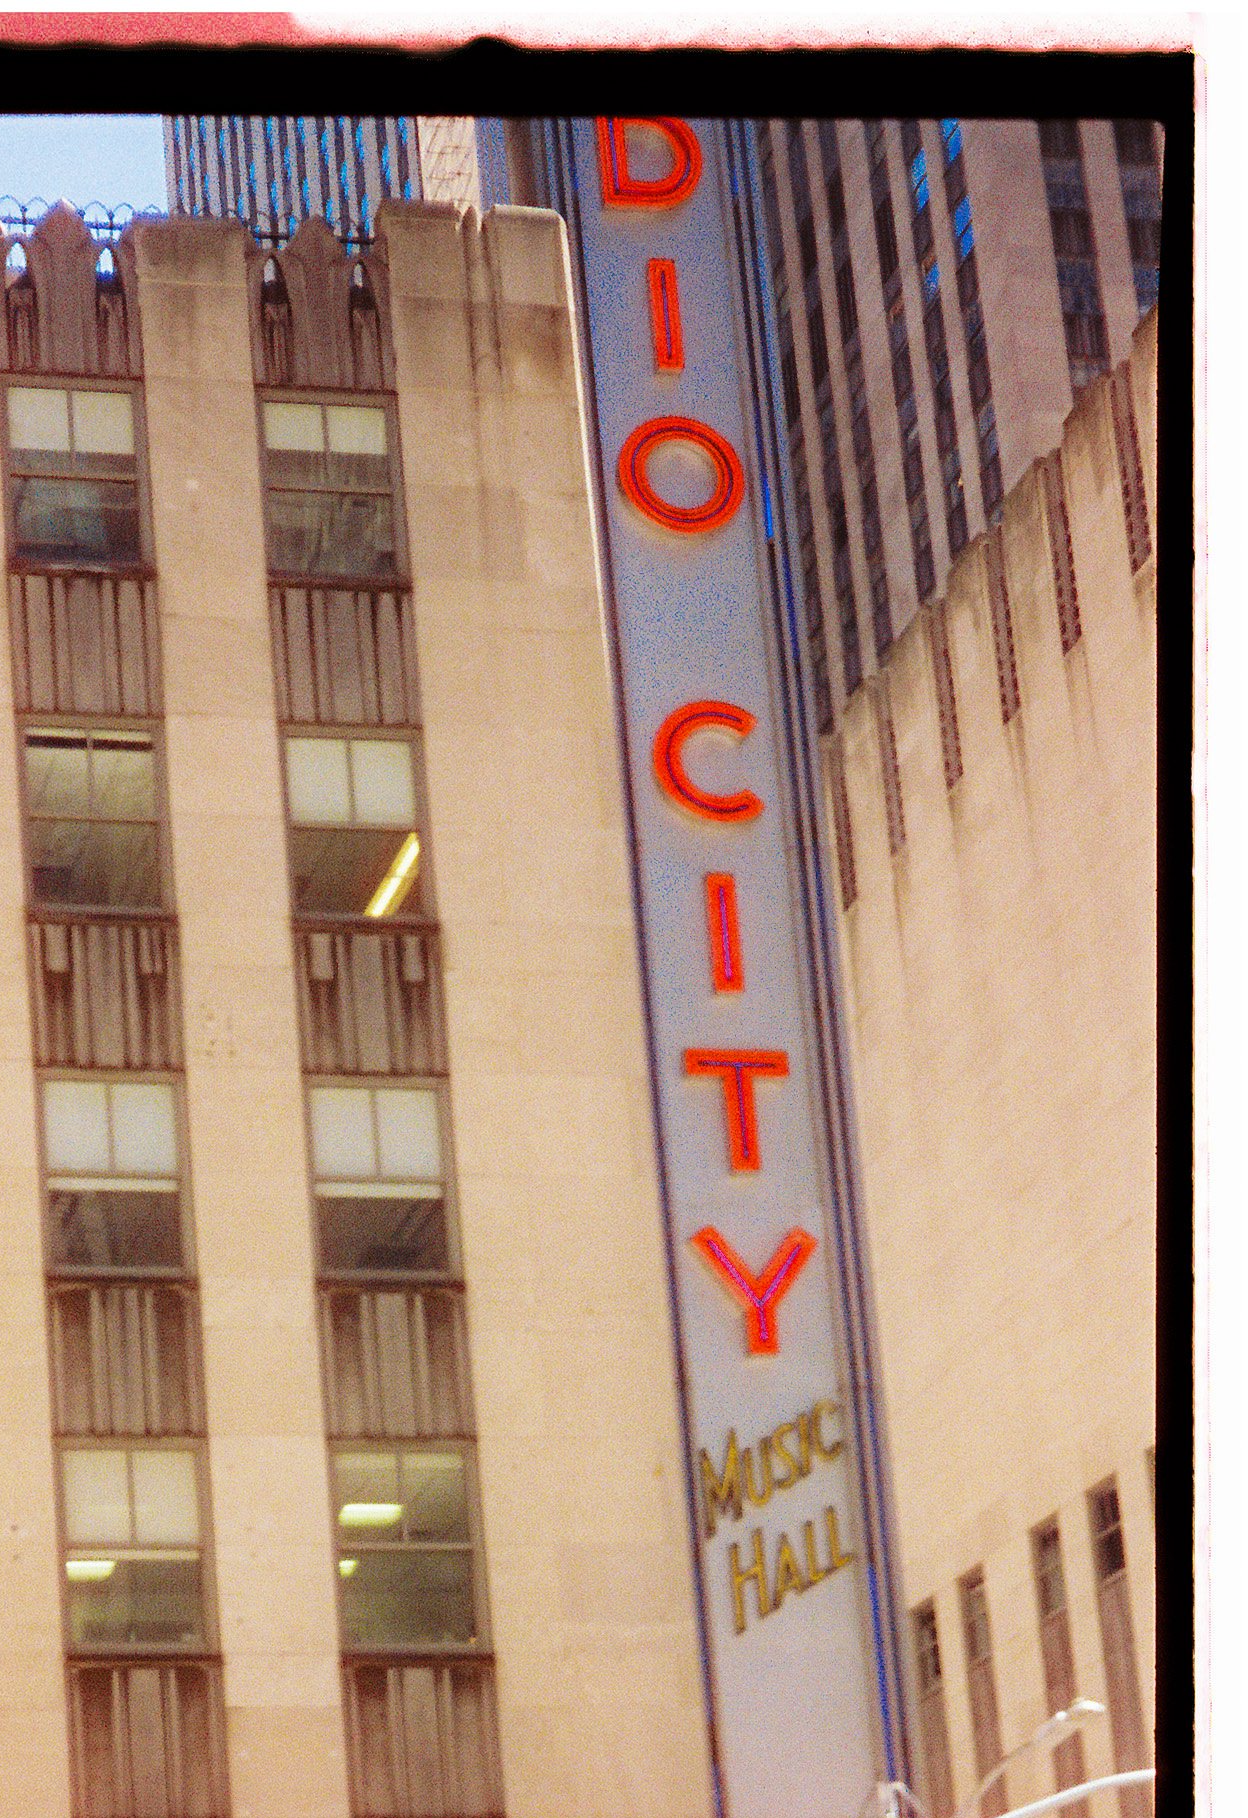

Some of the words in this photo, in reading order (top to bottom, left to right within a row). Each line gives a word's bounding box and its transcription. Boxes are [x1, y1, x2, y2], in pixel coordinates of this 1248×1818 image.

[653, 699, 819, 1357] CITY
[698, 1404, 844, 1538] MUSIC
[728, 1506, 857, 1637] HALL
